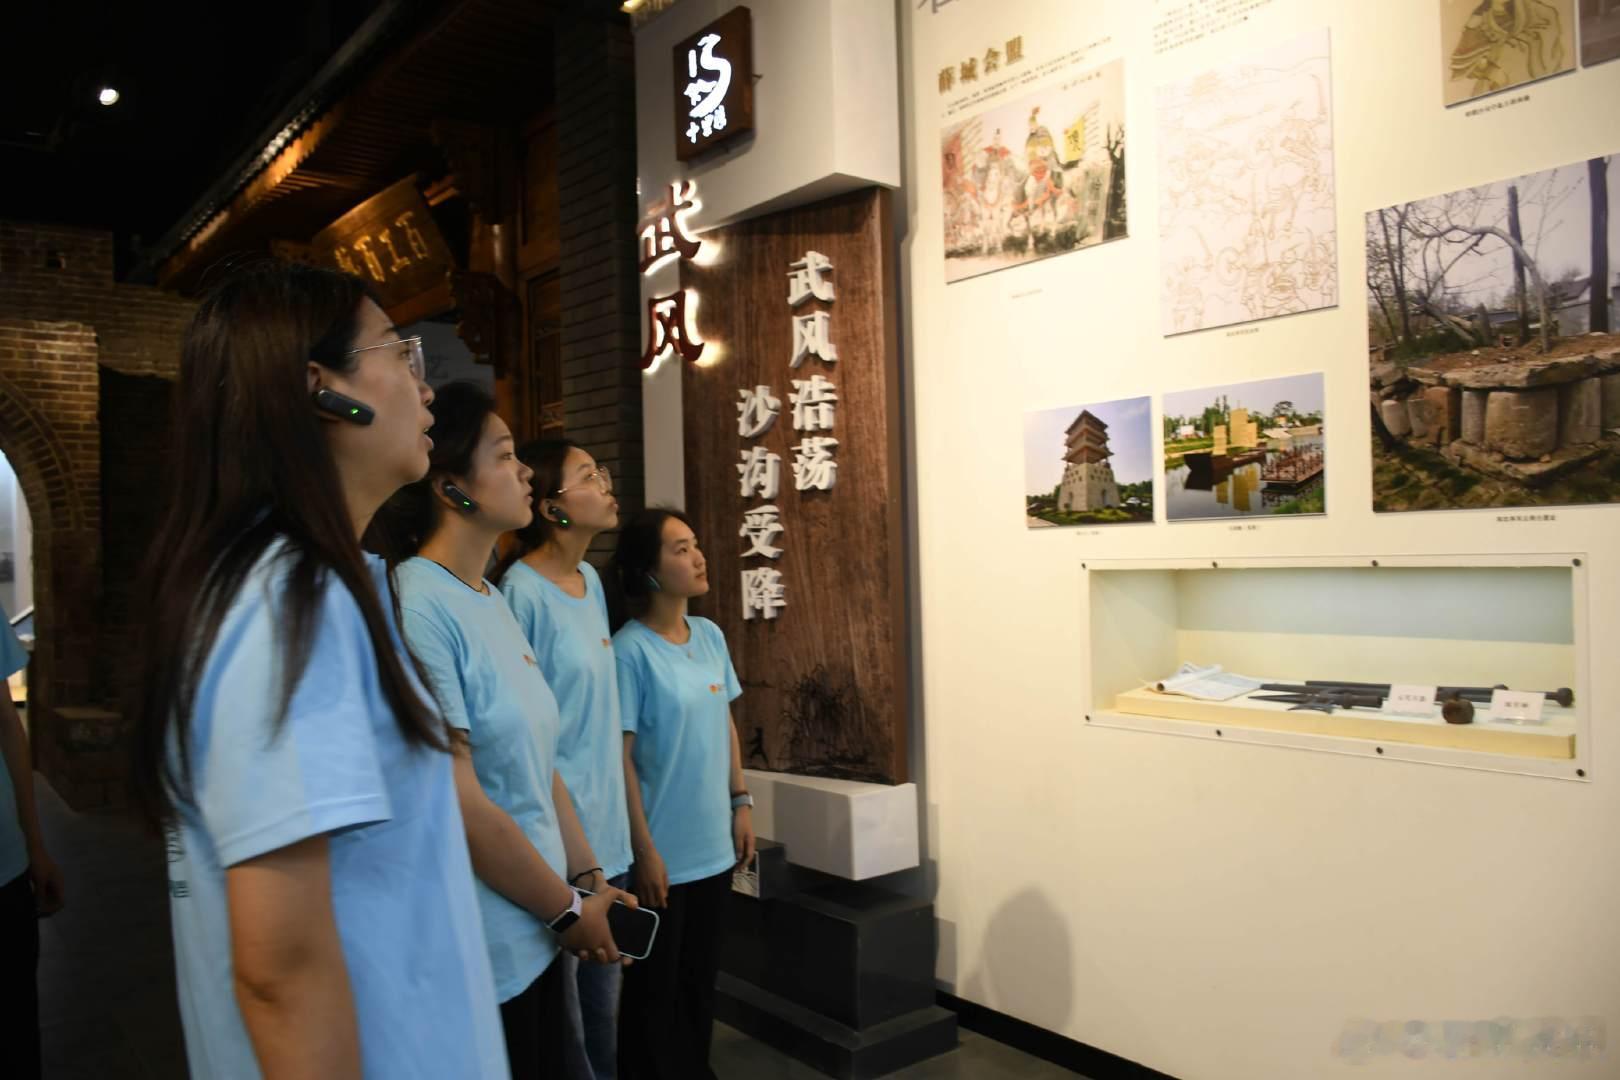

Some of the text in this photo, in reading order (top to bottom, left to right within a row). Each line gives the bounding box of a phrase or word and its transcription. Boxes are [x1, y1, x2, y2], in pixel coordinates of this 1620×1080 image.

[639, 180, 706, 373] 武风
[786, 249, 840, 492] 武风浩荡
[735, 384, 787, 622] 沙沟受降
